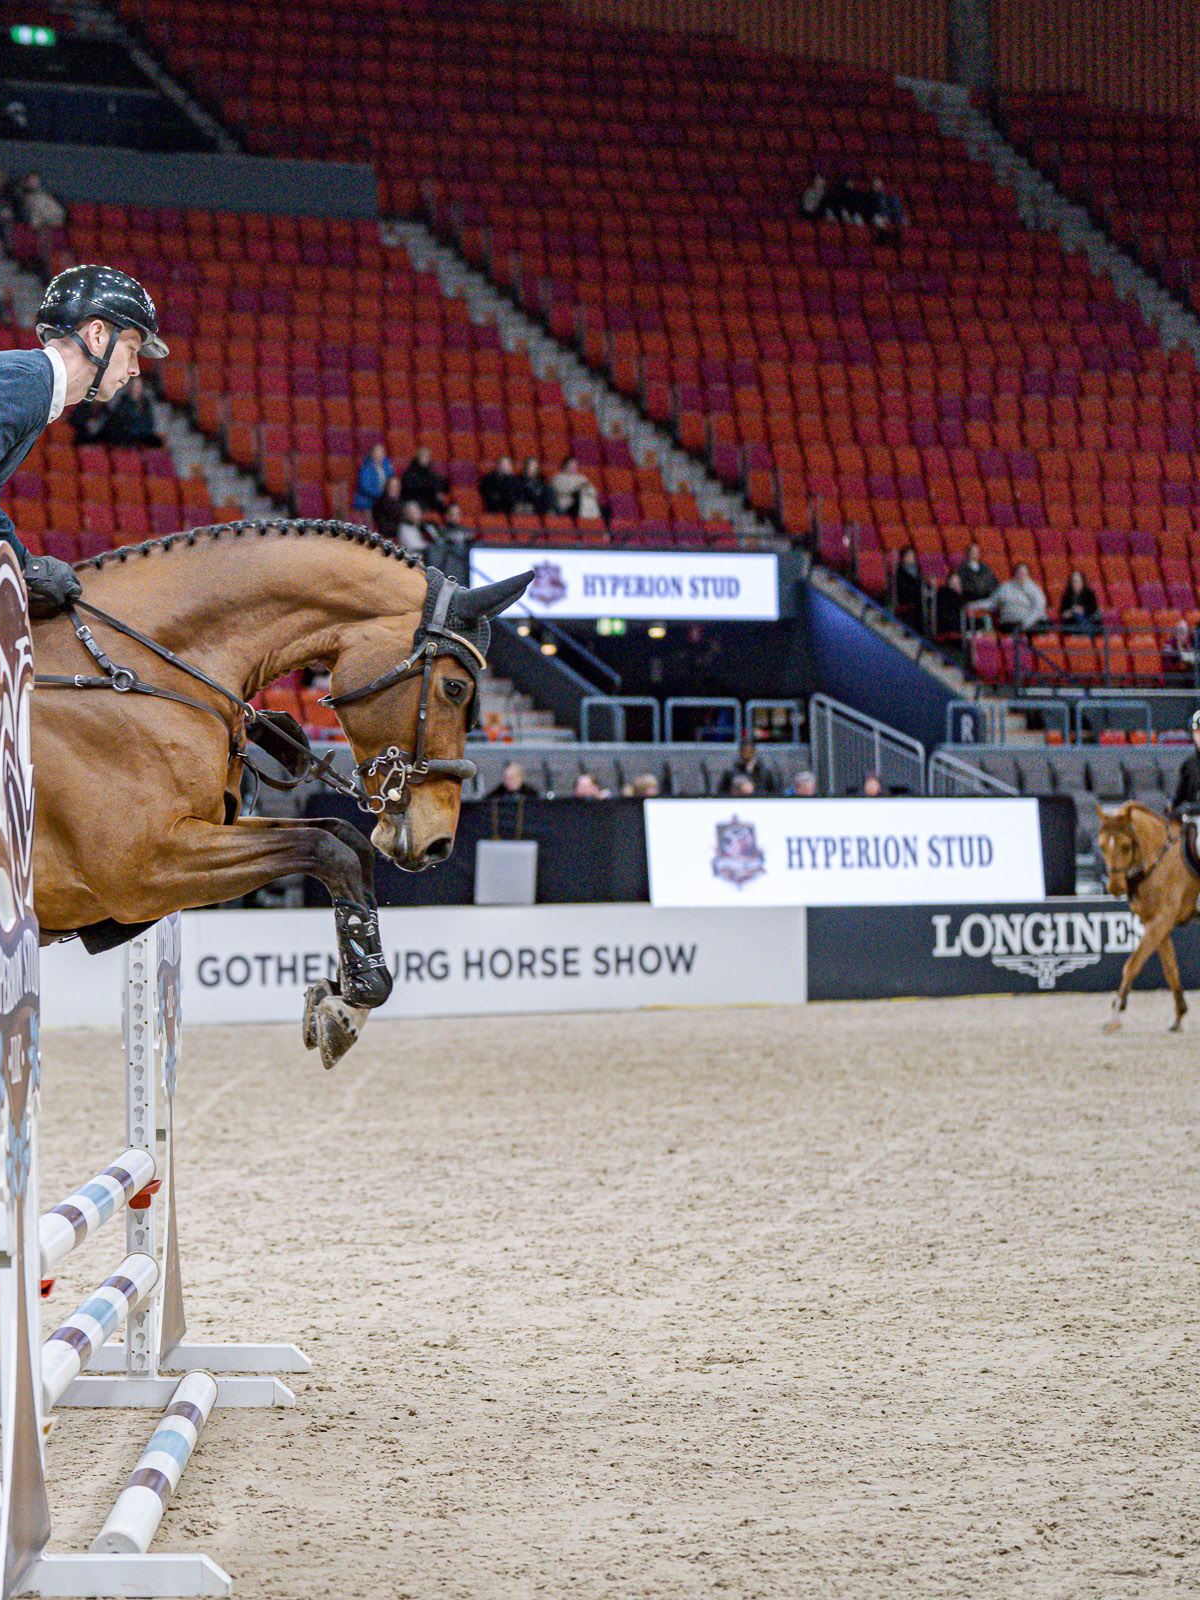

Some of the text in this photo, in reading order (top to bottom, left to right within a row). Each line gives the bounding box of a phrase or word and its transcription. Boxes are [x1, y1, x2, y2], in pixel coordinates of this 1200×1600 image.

[583, 574, 740, 599] HYPERION STUD
[786, 834, 994, 869] HYPERION STUD
[463, 946, 580, 980] HORSE
[594, 944, 697, 976] SHOW
